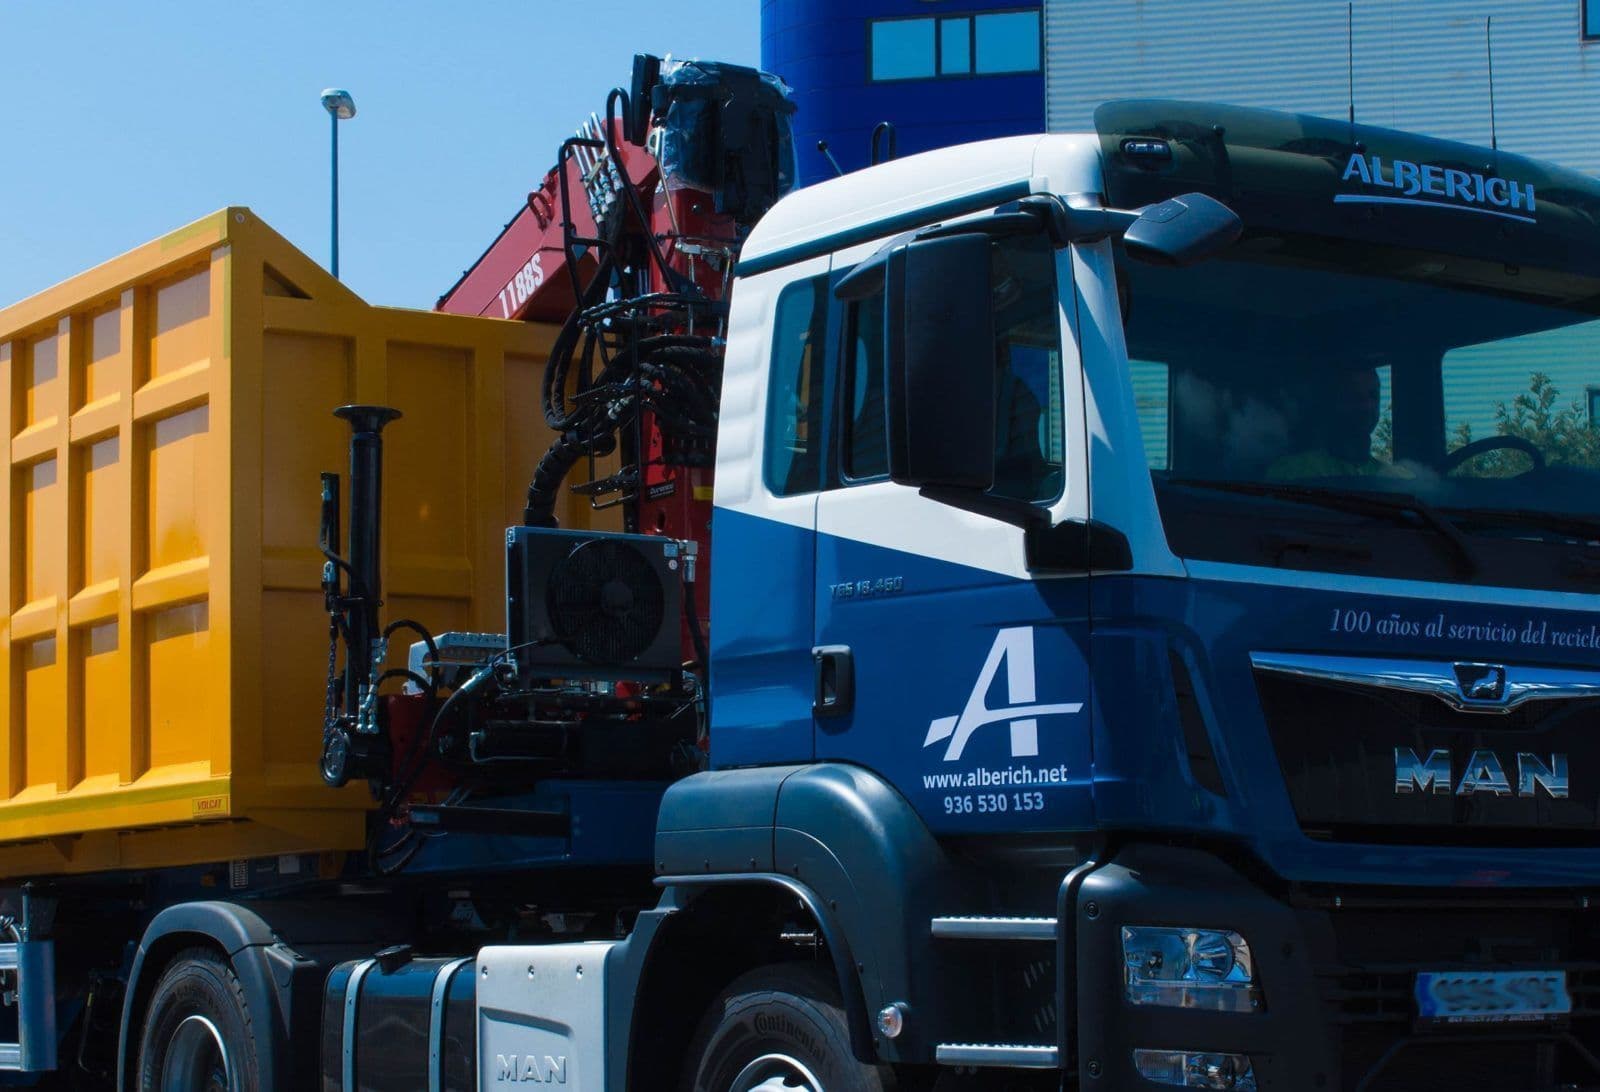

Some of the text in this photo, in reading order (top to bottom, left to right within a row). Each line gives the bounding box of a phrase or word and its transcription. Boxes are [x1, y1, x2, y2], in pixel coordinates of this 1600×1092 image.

[1342, 153, 1536, 211] ALBERICH
[1330, 608, 1372, 633] 100
[1376, 613, 1420, 636] años
[1425, 614, 1445, 638] al
[1448, 621, 1517, 643] servicio
[1520, 620, 1548, 645] del
[923, 764, 1068, 789] www.alberich.net
[1394, 747, 1569, 799] MAN
[944, 792, 1045, 814] 936 530 153
[496, 1054, 567, 1084] MAN
